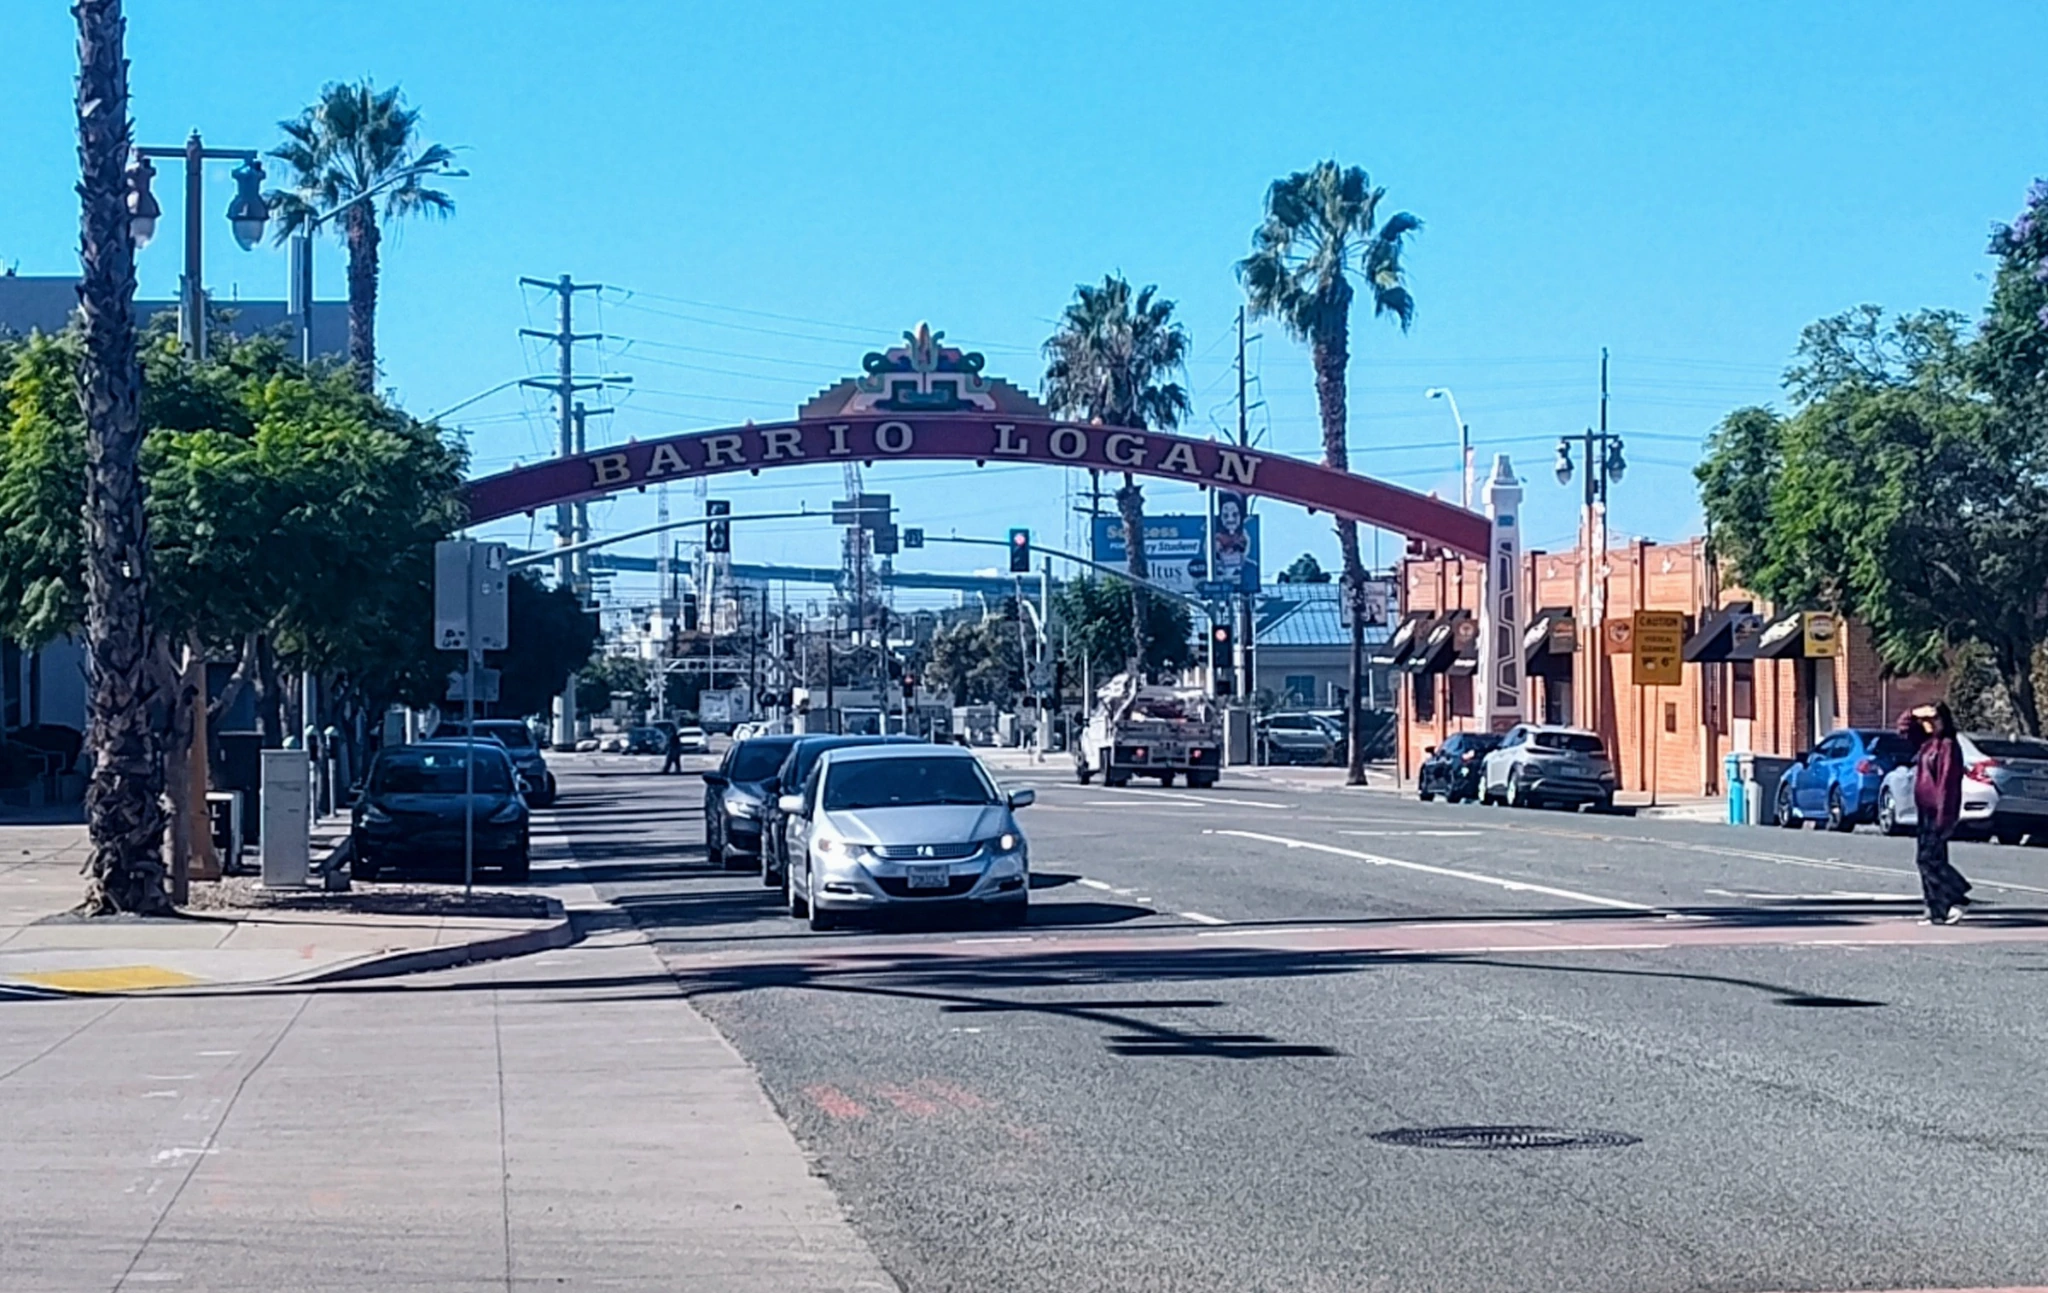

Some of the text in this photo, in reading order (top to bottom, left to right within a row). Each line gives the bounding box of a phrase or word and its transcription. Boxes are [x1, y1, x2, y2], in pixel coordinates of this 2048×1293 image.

[588, 421, 1262, 487] BARRIO LOGAN
[1639, 616, 1678, 627] CAUTION
